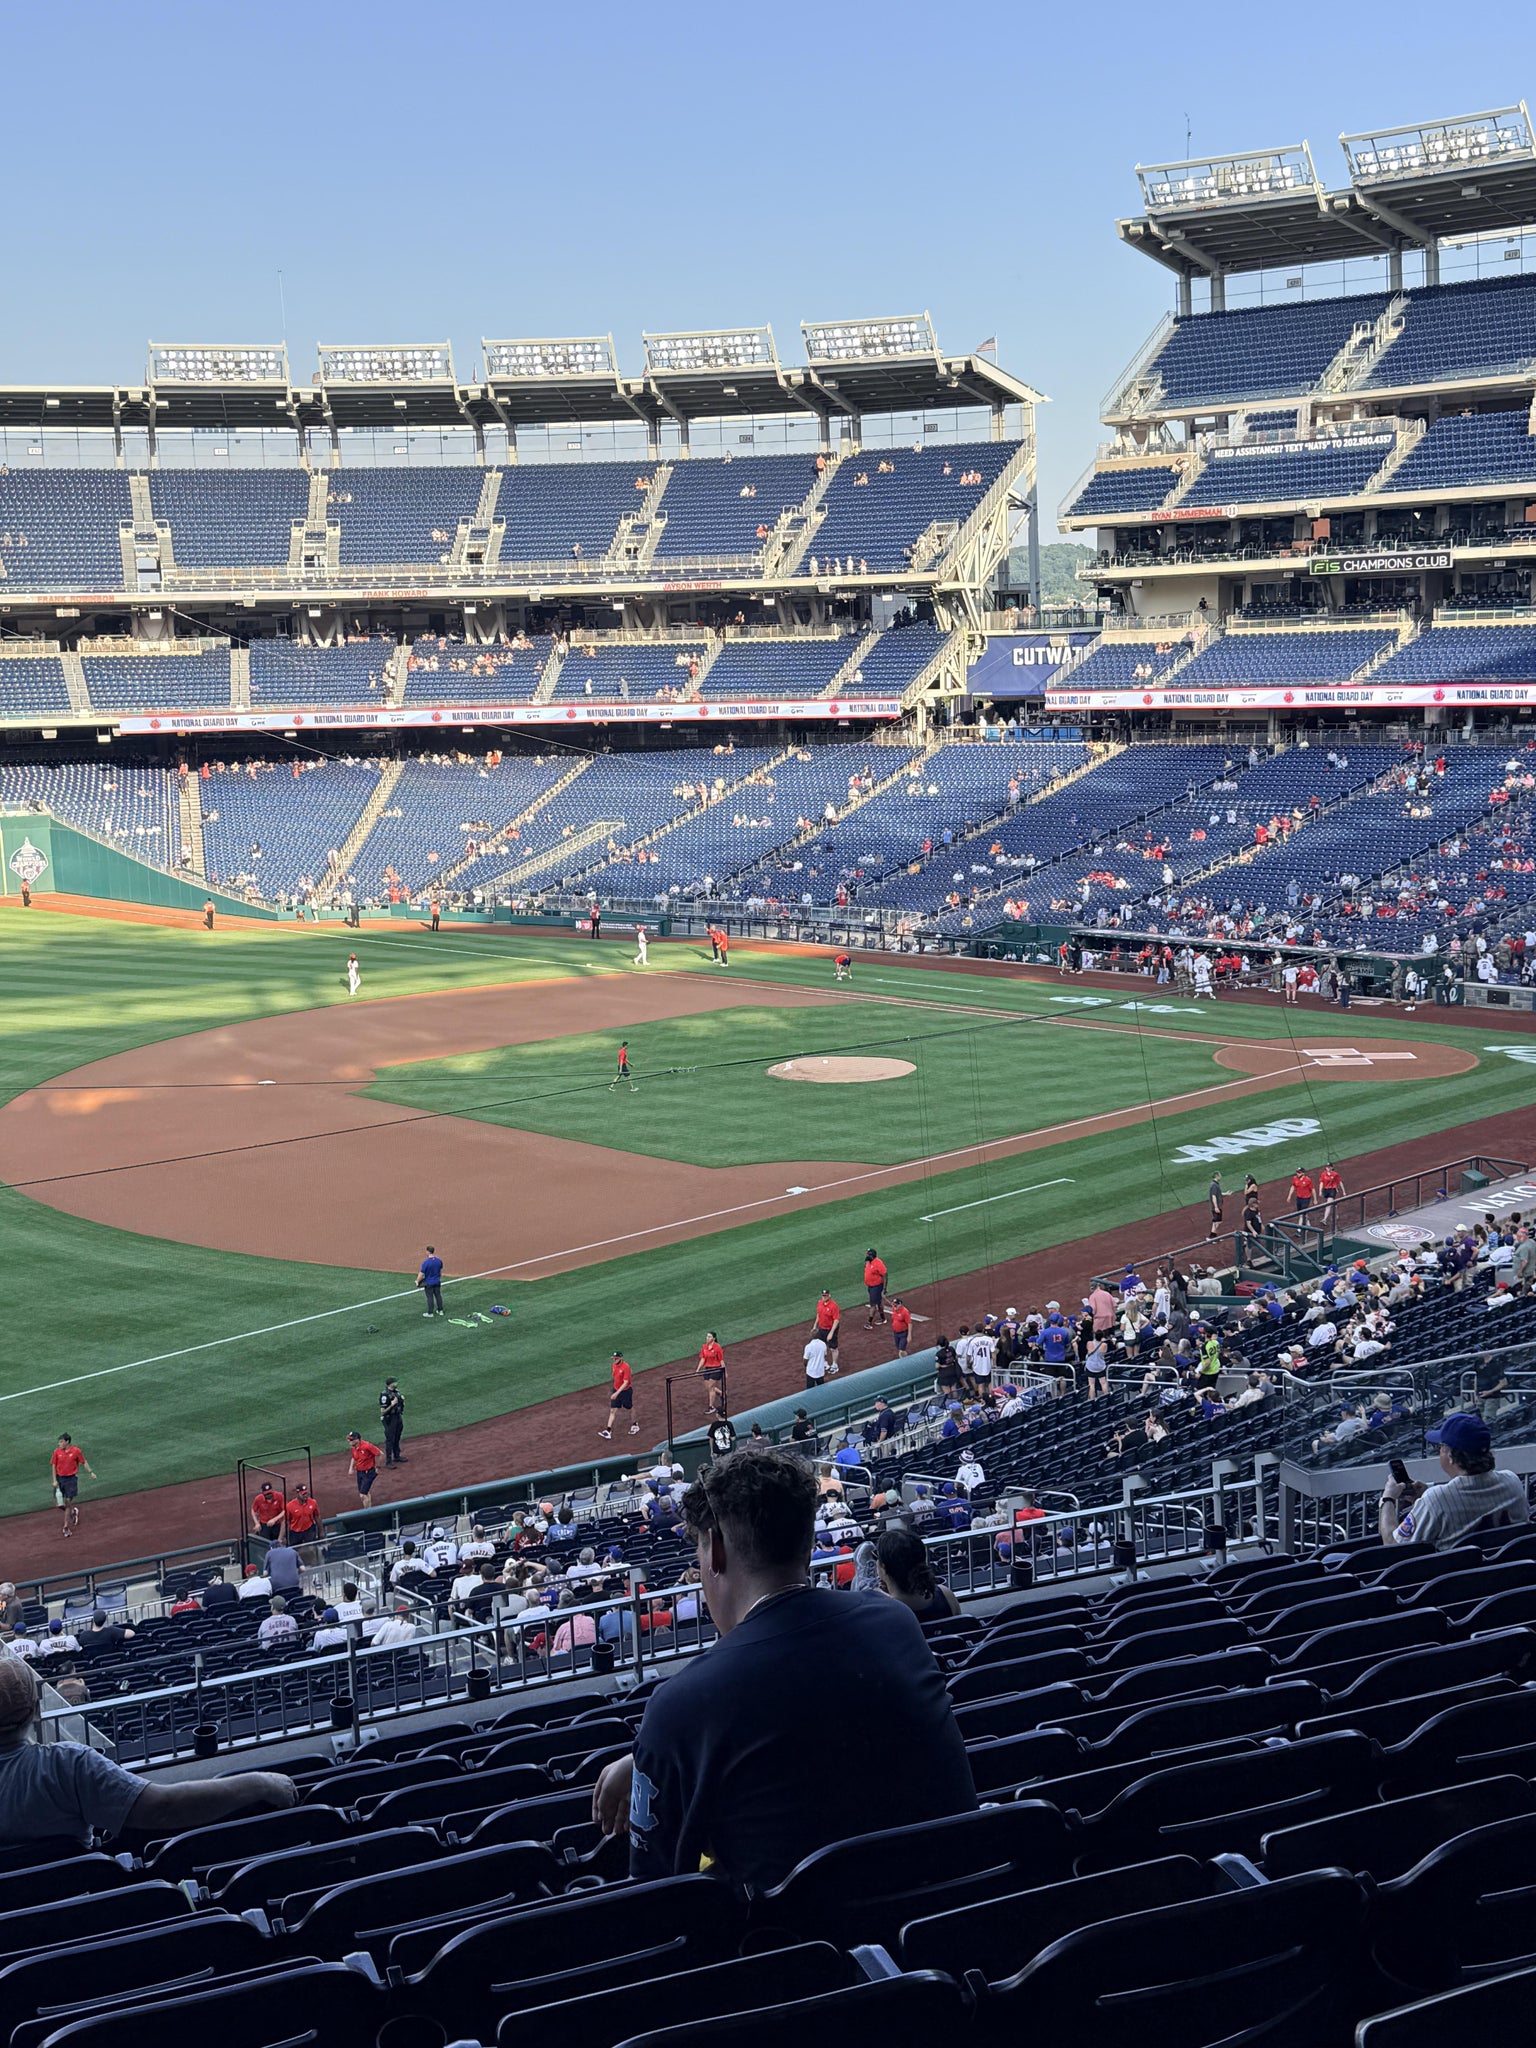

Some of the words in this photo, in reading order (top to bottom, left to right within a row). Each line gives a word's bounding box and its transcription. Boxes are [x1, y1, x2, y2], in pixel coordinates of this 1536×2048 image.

[1214, 448, 1234, 458] NEED
[1235, 446, 1283, 457] ASSISTANCE?
[1284, 444, 1303, 453] TEXT
[1332, 440, 1342, 448] TO
[1343, 434, 1392, 448] 202.980.4357
[1151, 511, 1171, 520] RYAN
[1173, 508, 1222, 519] ZIMMERMAN
[1343, 557, 1413, 571] CHAMPIONS
[1415, 555, 1448, 567] CLUB
[663, 583, 692, 592] JAYSON
[693, 582, 722, 590] WERTH
[362, 590, 390, 598] FRANK
[391, 589, 428, 598] HOWARD
[1013, 646, 1088, 666] CUTWAT
[1163, 694, 1193, 704] NATIONAL
[1194, 694, 1215, 703] GUARD
[1216, 693, 1229, 703] DAY
[1305, 691, 1335, 701] NATIONAL
[1337, 691, 1360, 701] GUARD
[1360, 691, 1374, 701] DAY
[1456, 689, 1488, 700] NATIONAL
[1489, 689, 1513, 699] GUARD
[1514, 689, 1529, 699] DAY
[1059, 695, 1078, 705] GUARD
[1079, 695, 1091, 704] DAY
[586, 709, 614, 718] NATIONAL
[616, 708, 635, 717] GUARD
[636, 708, 648, 717] DAY
[718, 706, 746, 715] NATIONAL
[747, 706, 767, 714] GUARD
[768, 705, 779, 714] DAY
[849, 704, 877, 713] NATIONAL
[878, 703, 897, 712] GUARD
[314, 715, 343, 724] NATIONAL
[344, 715, 365, 723] GUARD
[366, 714, 379, 723] DAY
[452, 712, 480, 721] NATIONAL
[481, 711, 502, 720] GUARD
[503, 711, 515, 719] DAY
[171, 718, 202, 727] NATIONAL
[203, 718, 224, 727] GUARD
[225, 717, 238, 726] DAY
[1170, 1117, 1323, 1163] AARP
[1052, 1334, 1062, 1343] 13
[976, 1347, 988, 1358] 41
[437, 1551, 448, 1566] 5
[14, 1644, 30, 1654] SOTO
